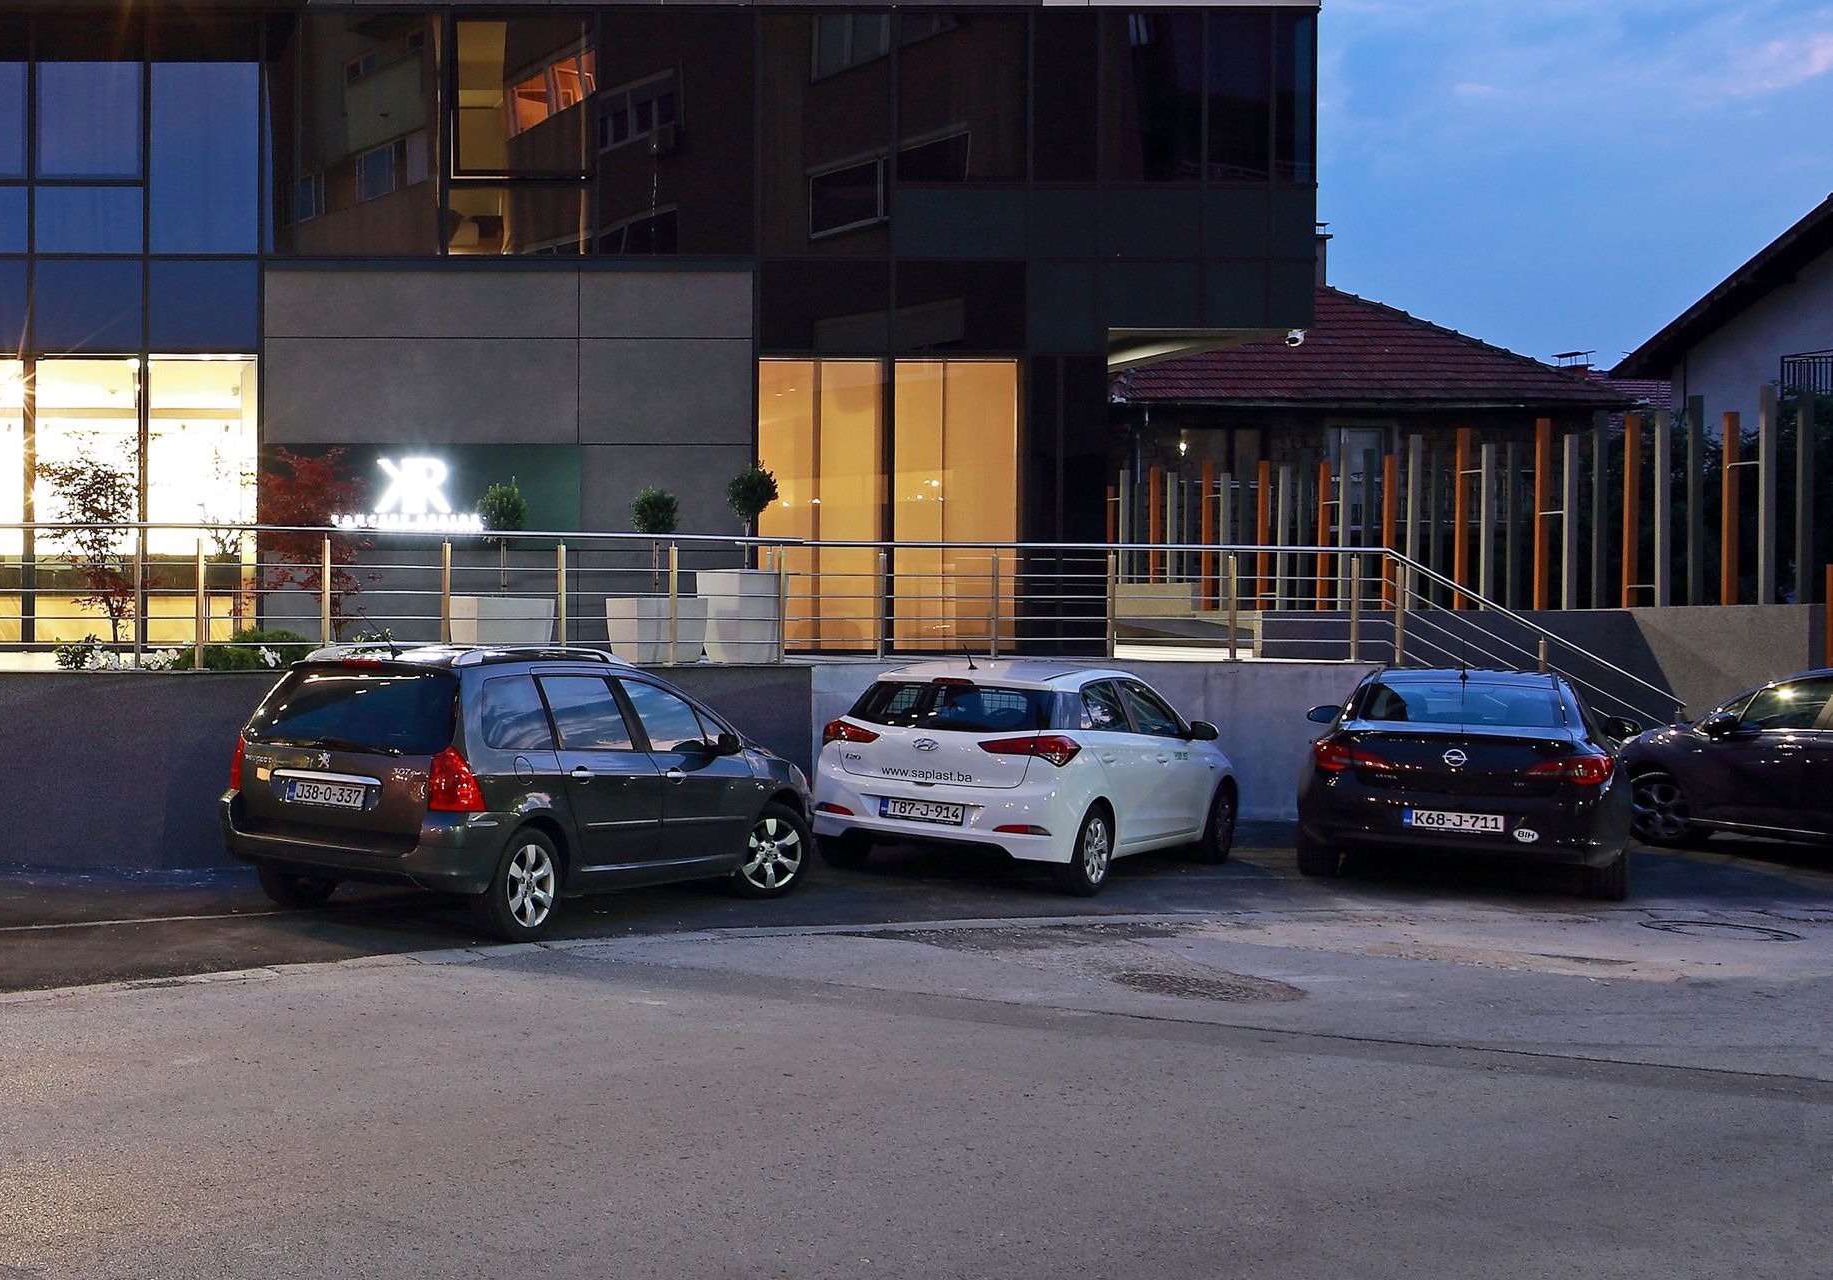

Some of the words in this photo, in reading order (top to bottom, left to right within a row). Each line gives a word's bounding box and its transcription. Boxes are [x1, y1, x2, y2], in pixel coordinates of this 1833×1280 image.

[881, 766, 973, 783] www.saplast.ba
[891, 800, 960, 820] T87-J-914
[1414, 811, 1501, 830] K68-J-711
[1517, 830, 1535, 840] BIH
